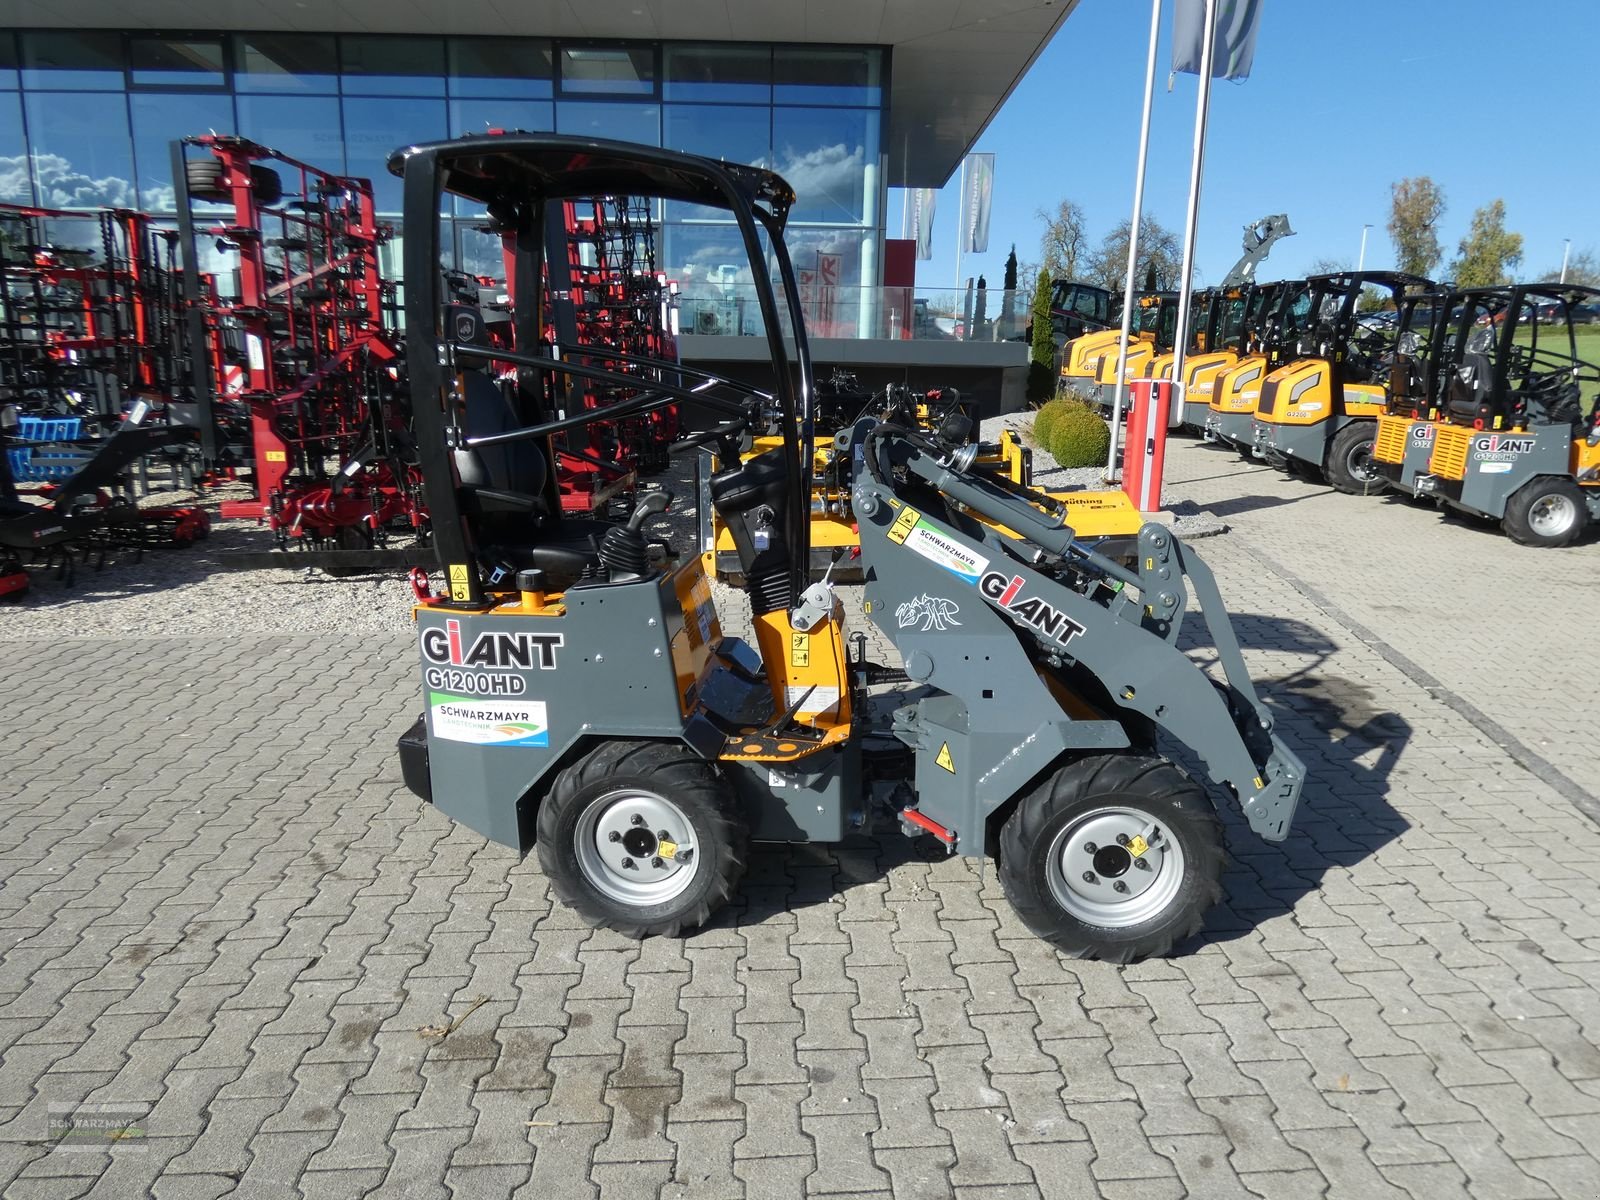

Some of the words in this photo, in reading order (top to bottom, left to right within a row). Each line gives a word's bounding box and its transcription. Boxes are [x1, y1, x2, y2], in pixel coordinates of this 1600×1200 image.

[920, 529, 976, 567] SCHWARZMAYR
[426, 668, 526, 696] G1200HD
[440, 705, 529, 722] SCHWARZMAYR
